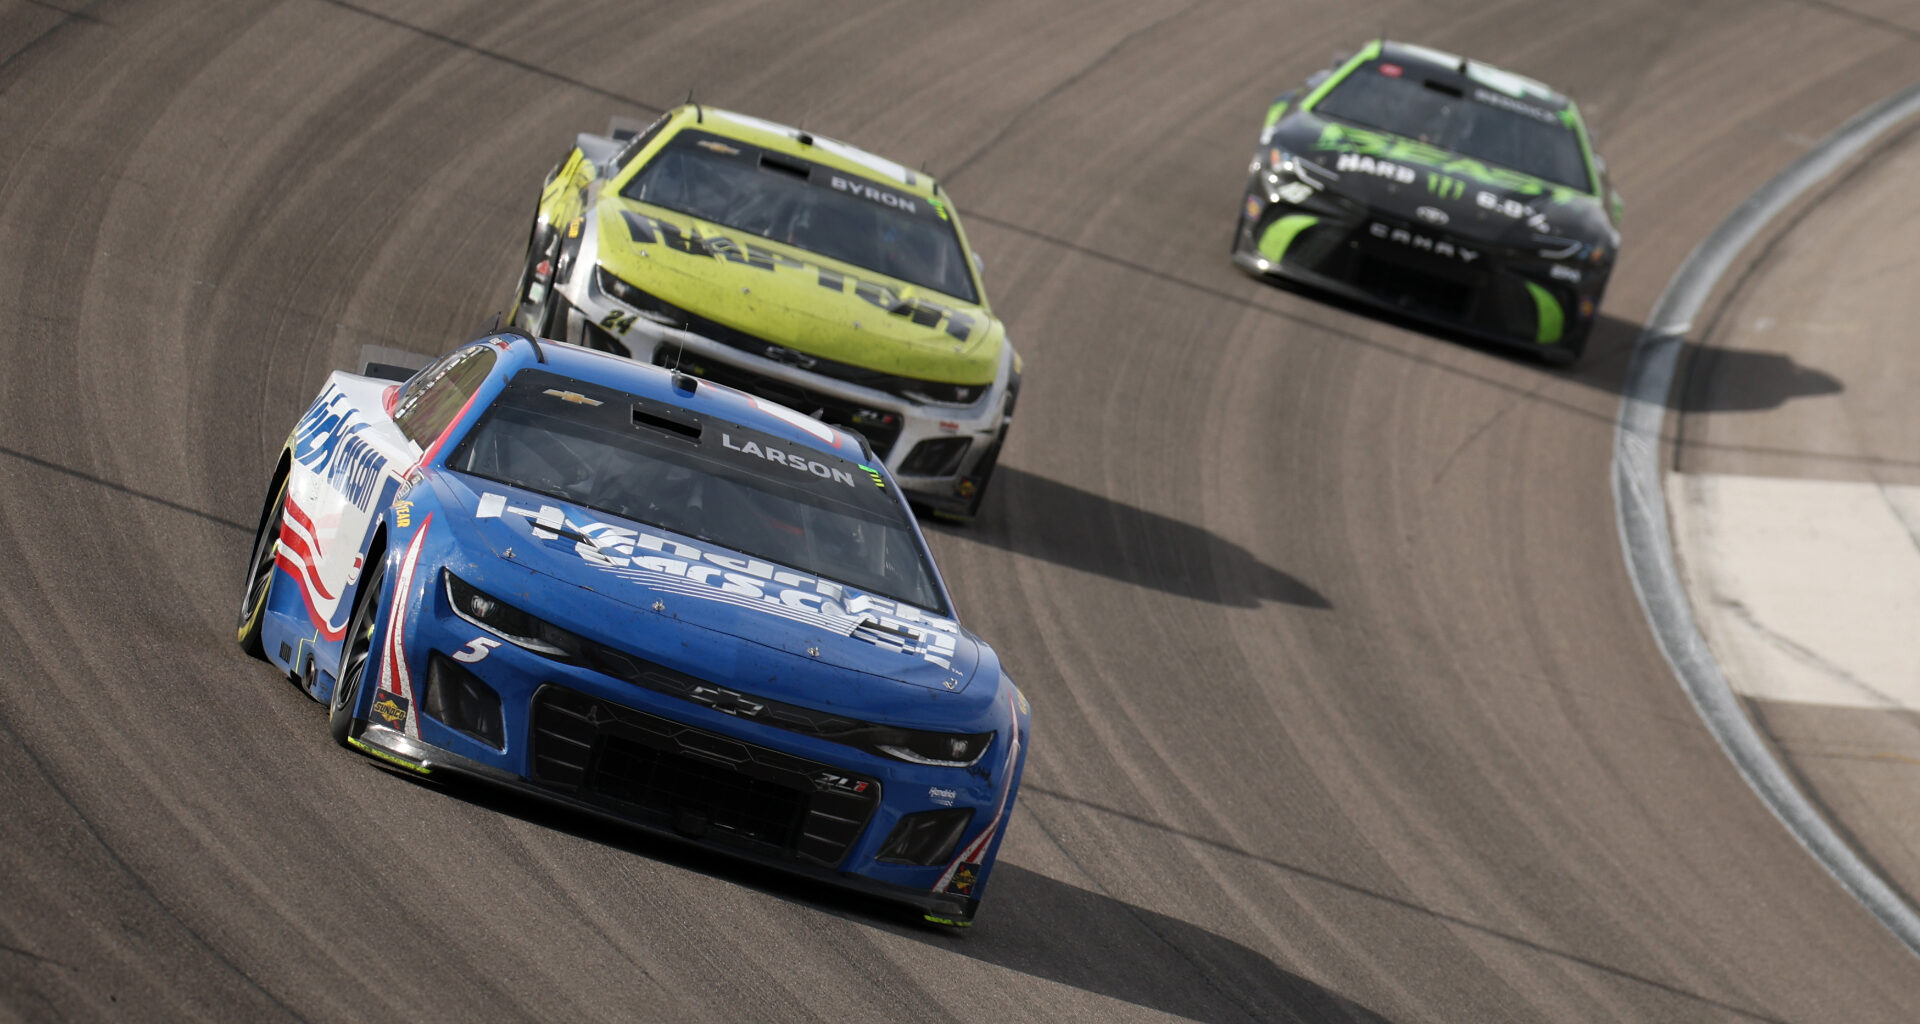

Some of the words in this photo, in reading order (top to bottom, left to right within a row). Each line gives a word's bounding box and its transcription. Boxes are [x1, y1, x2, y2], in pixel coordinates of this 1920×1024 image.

[1336, 152, 1416, 184] HARD
[831, 175, 916, 214] BYRON
[600, 309, 638, 336] 24
[721, 433, 856, 488] LARSON
[451, 636, 503, 664] 5
[373, 701, 407, 721] SUNOCO
